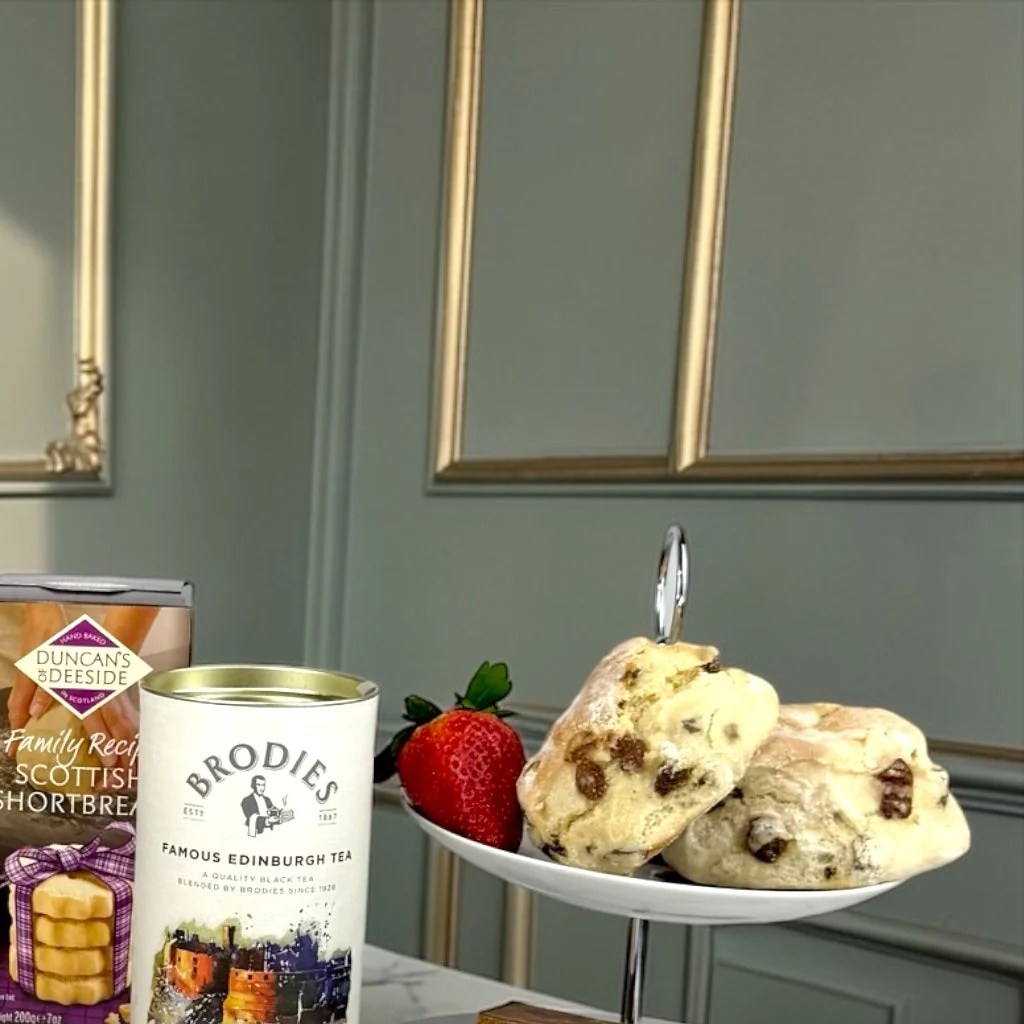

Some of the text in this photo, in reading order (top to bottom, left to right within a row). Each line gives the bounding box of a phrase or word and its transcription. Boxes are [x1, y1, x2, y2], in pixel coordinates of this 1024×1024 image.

[60, 632, 107, 646] HAND BAKED
[36, 650, 131, 669] DUNCAN'S
[49, 668, 128, 686] DEESIDE
[69, 692, 106, 704] SCOTLAND
[4, 728, 85, 768] Family
[15, 763, 139, 789] SCOTTISH
[186, 741, 338, 804] BRODIES
[162, 842, 352, 867] FAMOUS EDINBURGH TEA
[177, 877, 220, 891] BLENDED
[223, 884, 236, 893] BY
[239, 885, 285, 895] BRODIES
[288, 886, 316, 894] SINCE
[201, 871, 314, 884] A QUALITY BLACK TEA
